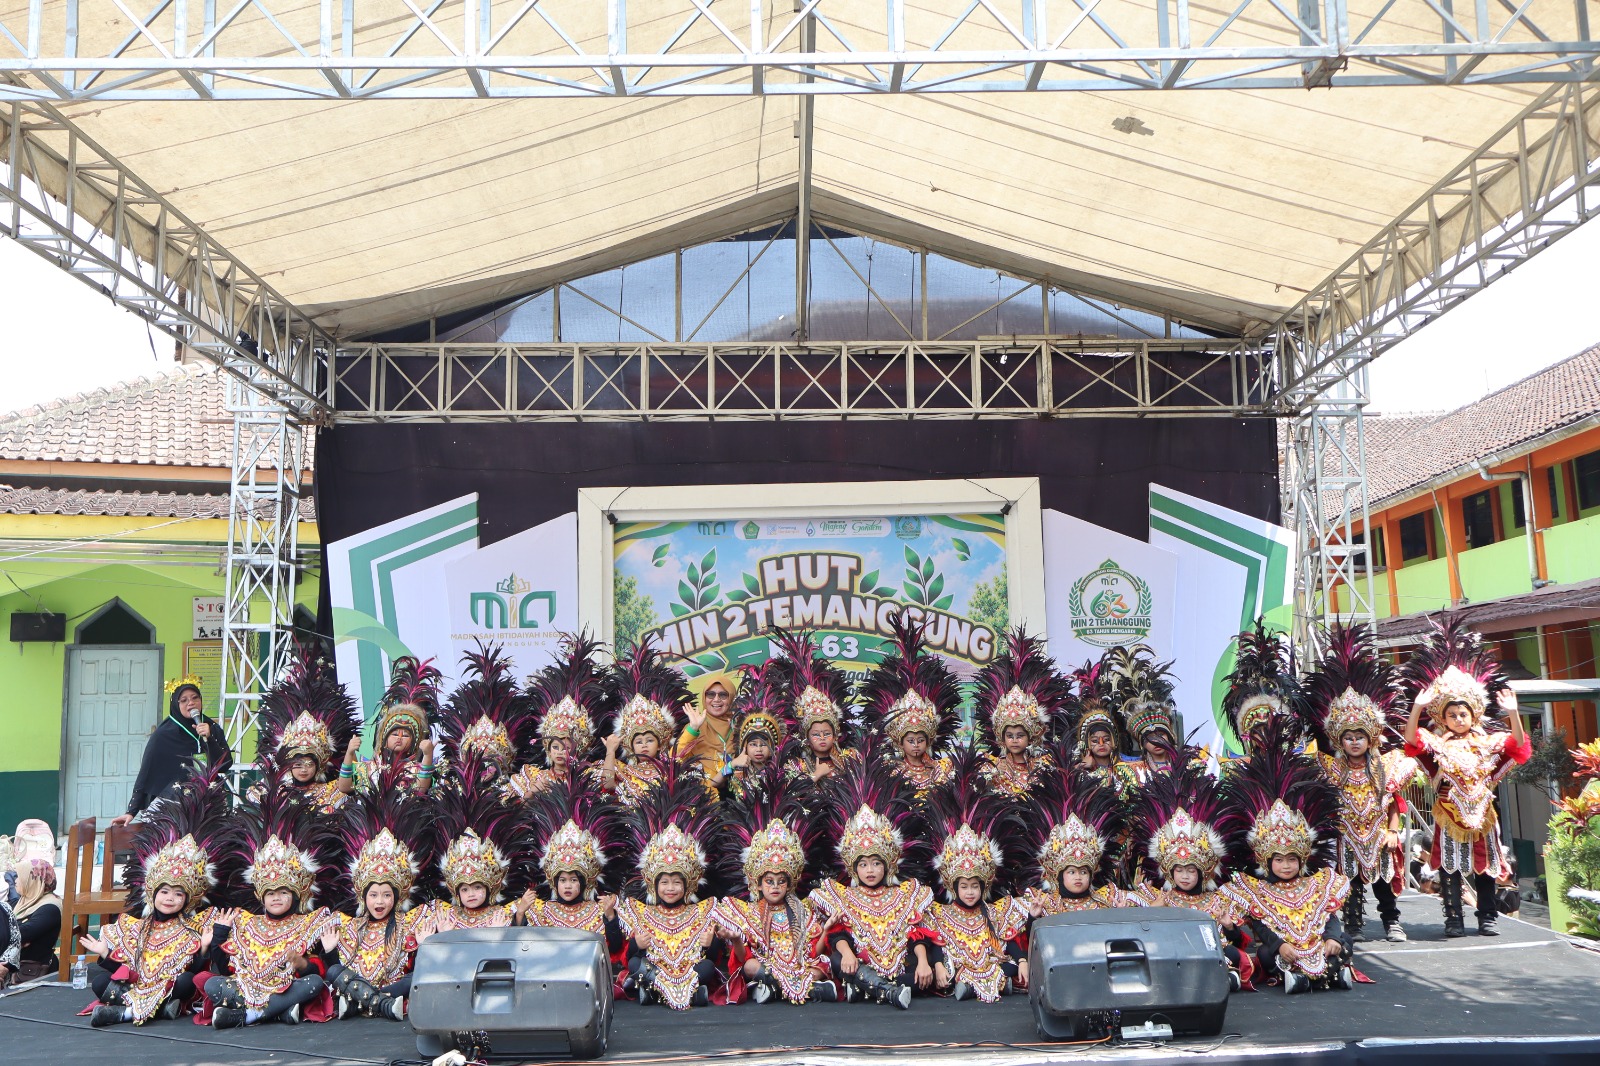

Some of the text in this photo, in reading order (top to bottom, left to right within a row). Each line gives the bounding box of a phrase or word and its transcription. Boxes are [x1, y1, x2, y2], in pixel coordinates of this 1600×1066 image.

[763, 555, 857, 594] HUT
[1071, 617, 1152, 628] MIN 2 TEMANGGUNG
[450, 633, 495, 641] MADRASAH
[497, 631, 541, 640] IBTIDAIYAH
[645, 611, 721, 667] MIN
[723, 606, 749, 640] 2
